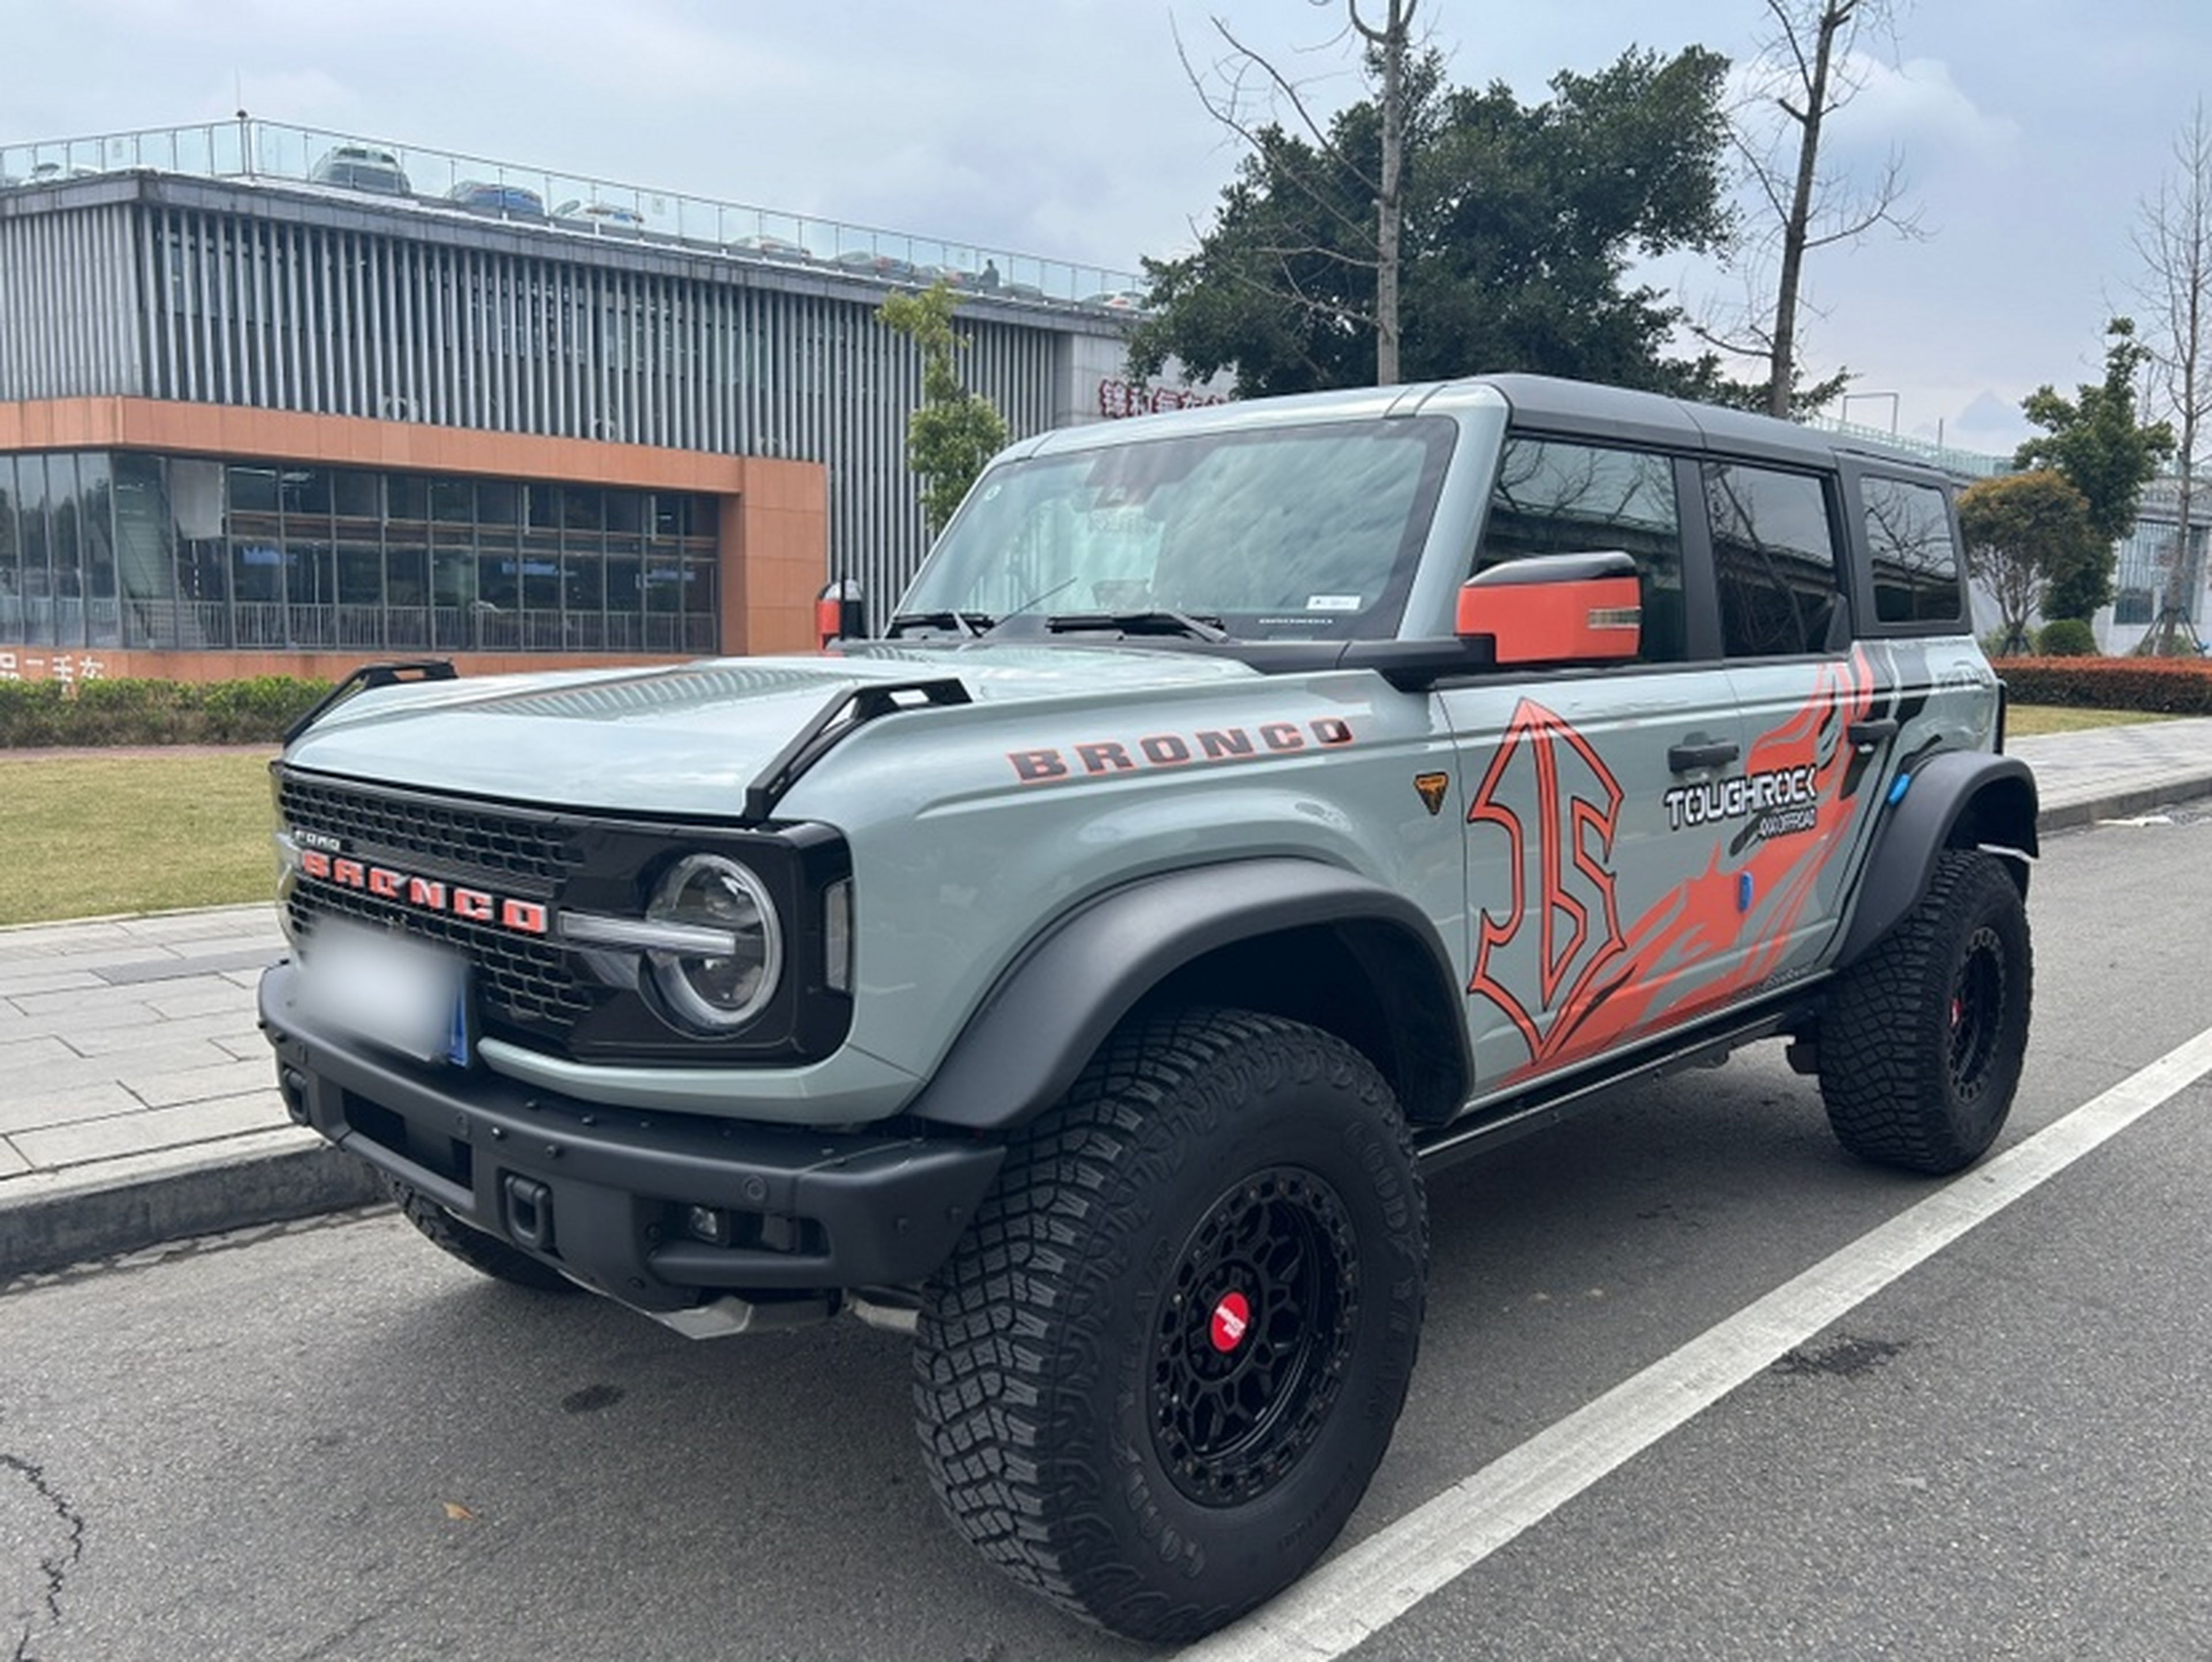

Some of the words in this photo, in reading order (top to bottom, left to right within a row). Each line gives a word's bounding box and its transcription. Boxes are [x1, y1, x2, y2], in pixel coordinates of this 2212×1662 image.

[1007, 718, 1353, 783] BRONCO
[1665, 766, 1817, 829] TOUGHROCK
[295, 830, 340, 852] FORD
[302, 850, 547, 933] BRONCO
